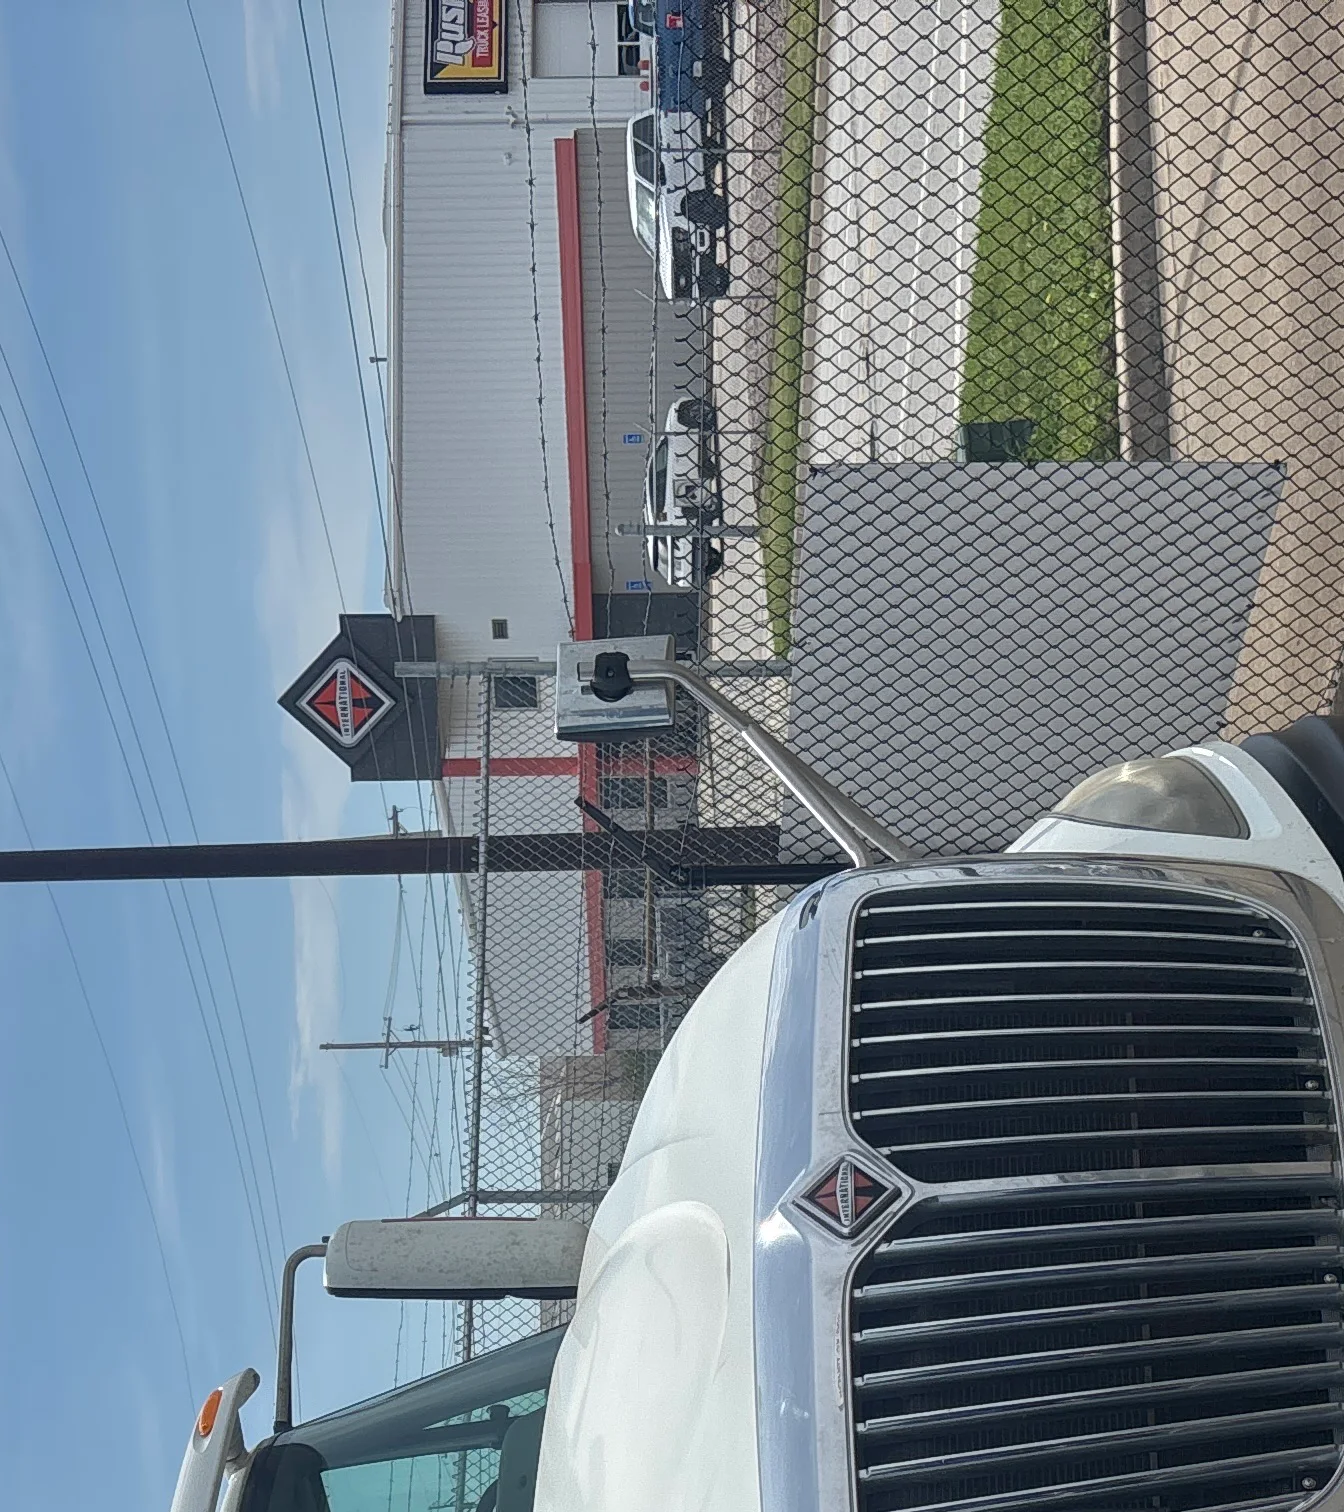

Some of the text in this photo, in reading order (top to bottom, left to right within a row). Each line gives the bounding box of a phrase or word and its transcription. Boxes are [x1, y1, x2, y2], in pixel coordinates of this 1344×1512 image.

[476, 30, 489, 57] TRUCK
[338, 670, 350, 736] INTERNATIONAL
[839, 1163, 850, 1222] INTERNATIONAL
